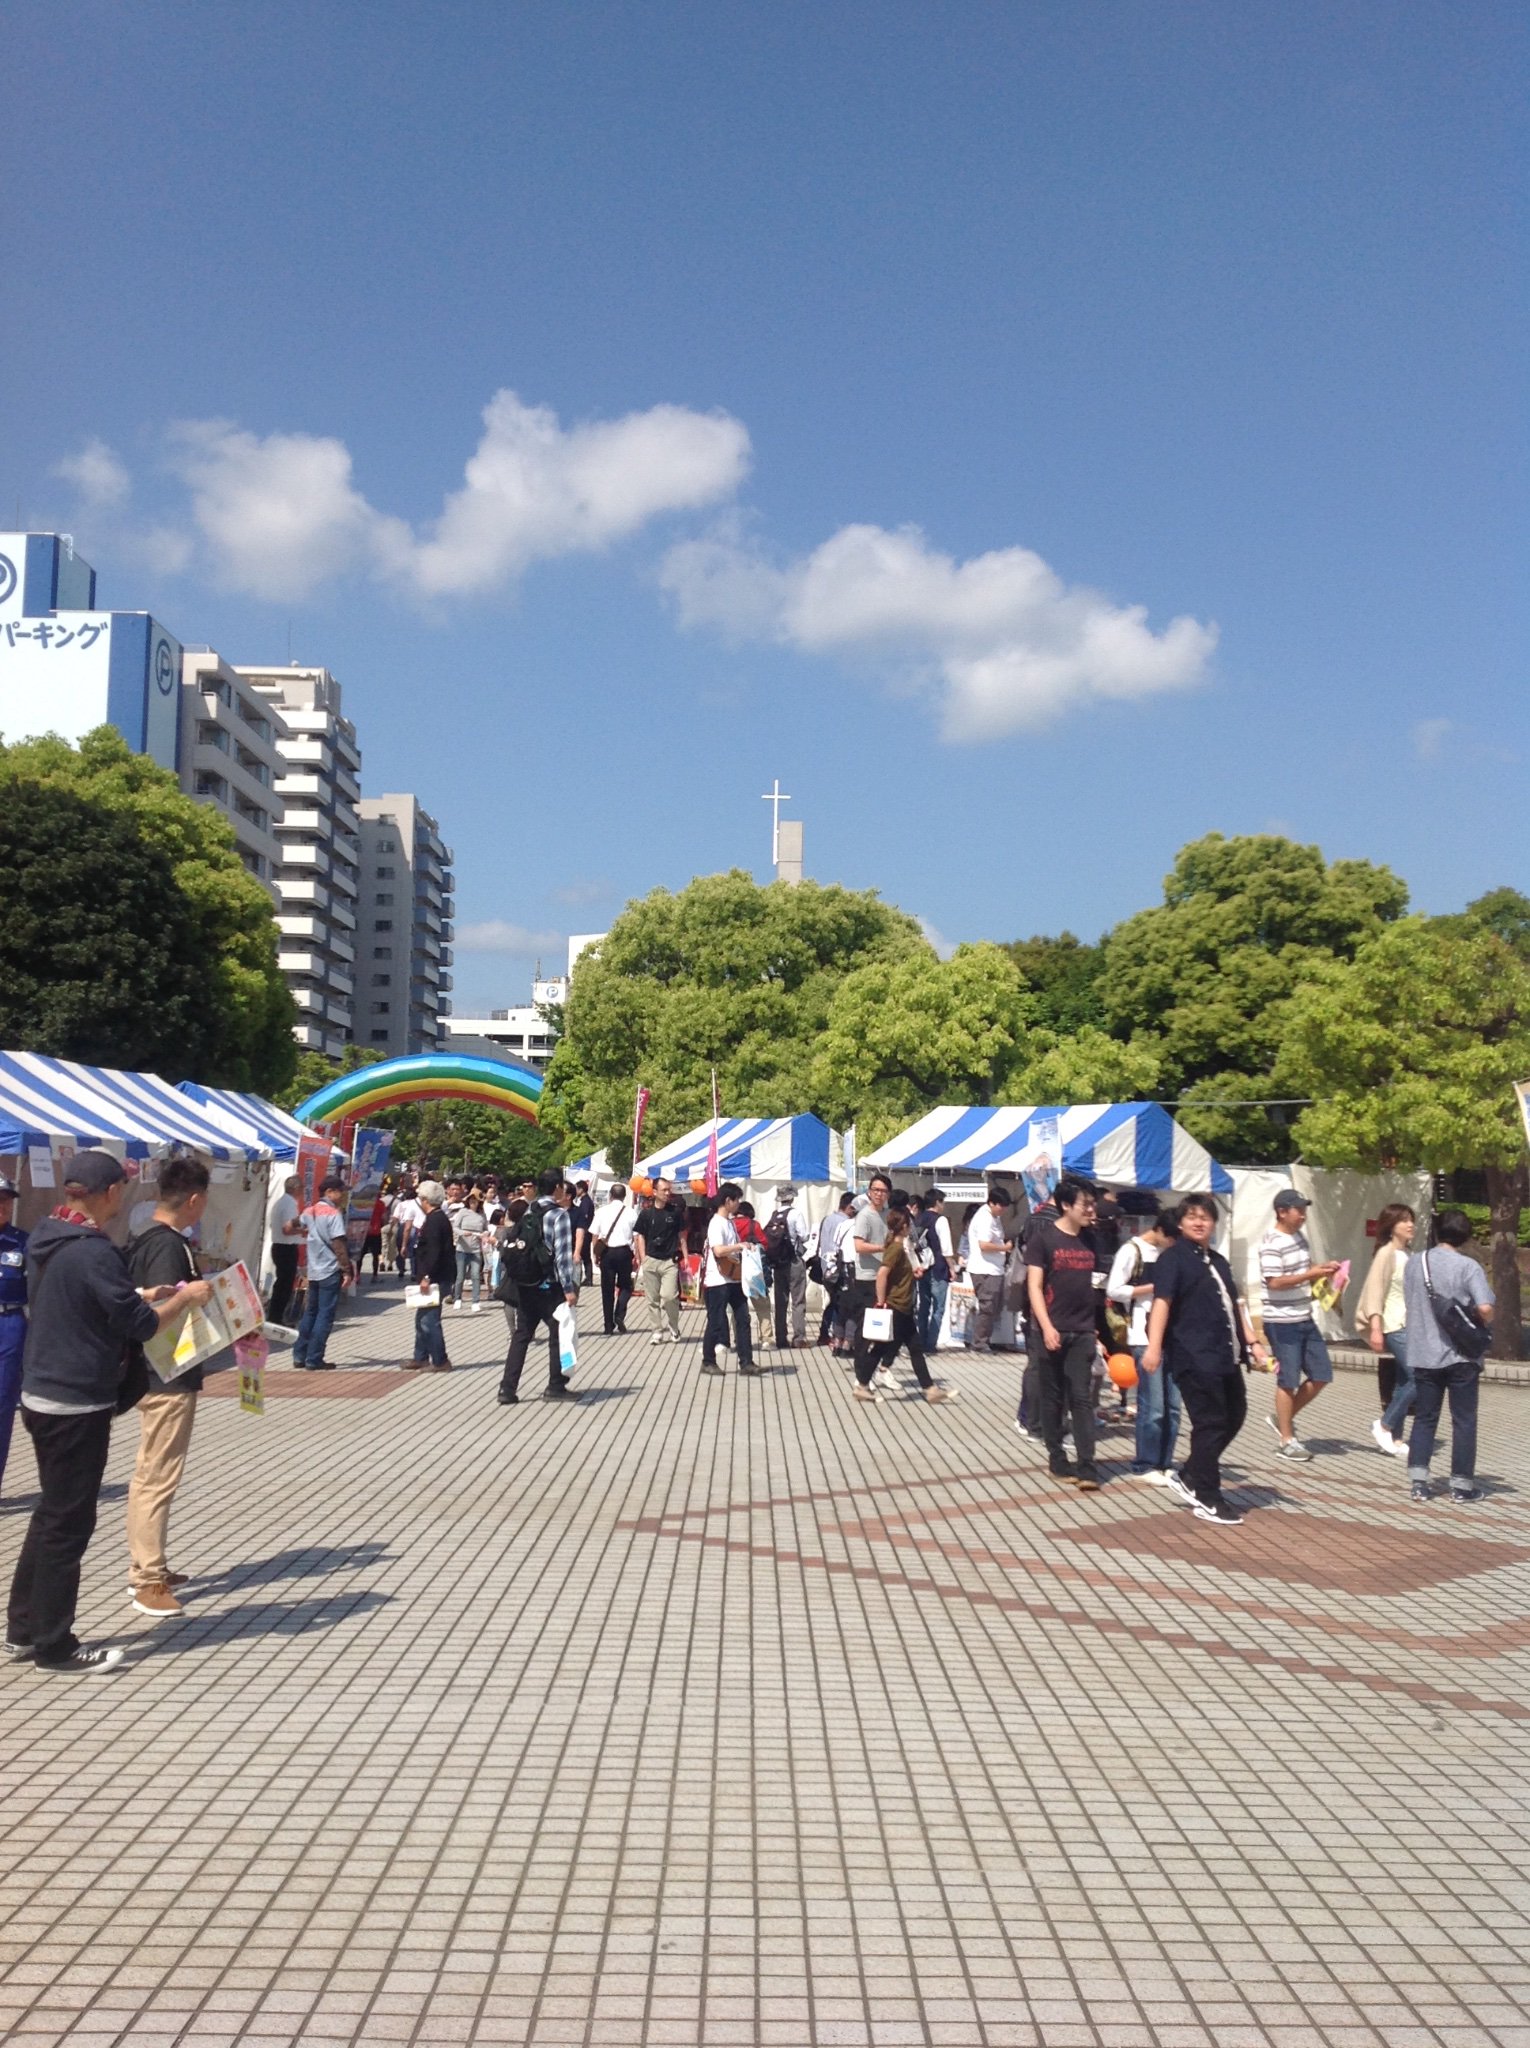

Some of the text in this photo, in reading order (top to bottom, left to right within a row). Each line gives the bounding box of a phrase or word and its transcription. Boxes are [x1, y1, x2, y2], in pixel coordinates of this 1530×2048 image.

[0, 622, 108, 649] パーキング
